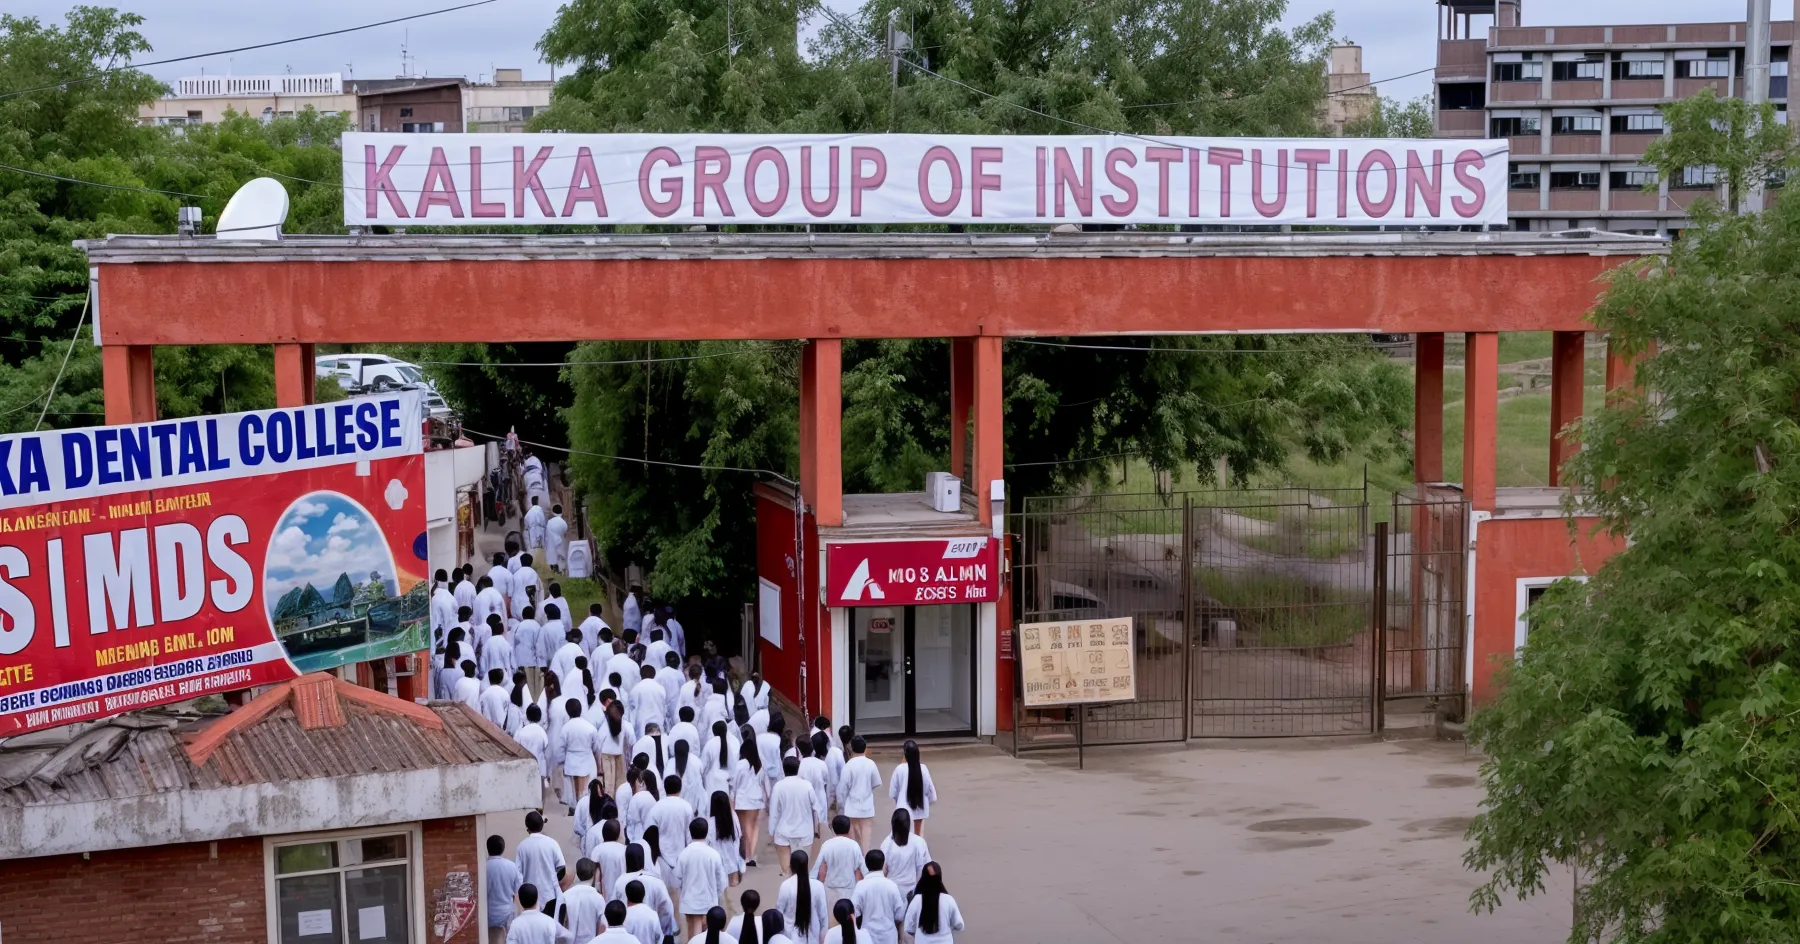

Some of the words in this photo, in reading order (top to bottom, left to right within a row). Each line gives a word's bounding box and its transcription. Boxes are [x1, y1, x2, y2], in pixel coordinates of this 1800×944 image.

[364, 144, 609, 219] KALKA
[638, 145, 888, 218] GROUP
[917, 145, 1003, 219] OF
[1035, 145, 1487, 219] INSTITUTIONS
[61, 418, 230, 489] DENTAL
[83, 514, 254, 636] MDS
